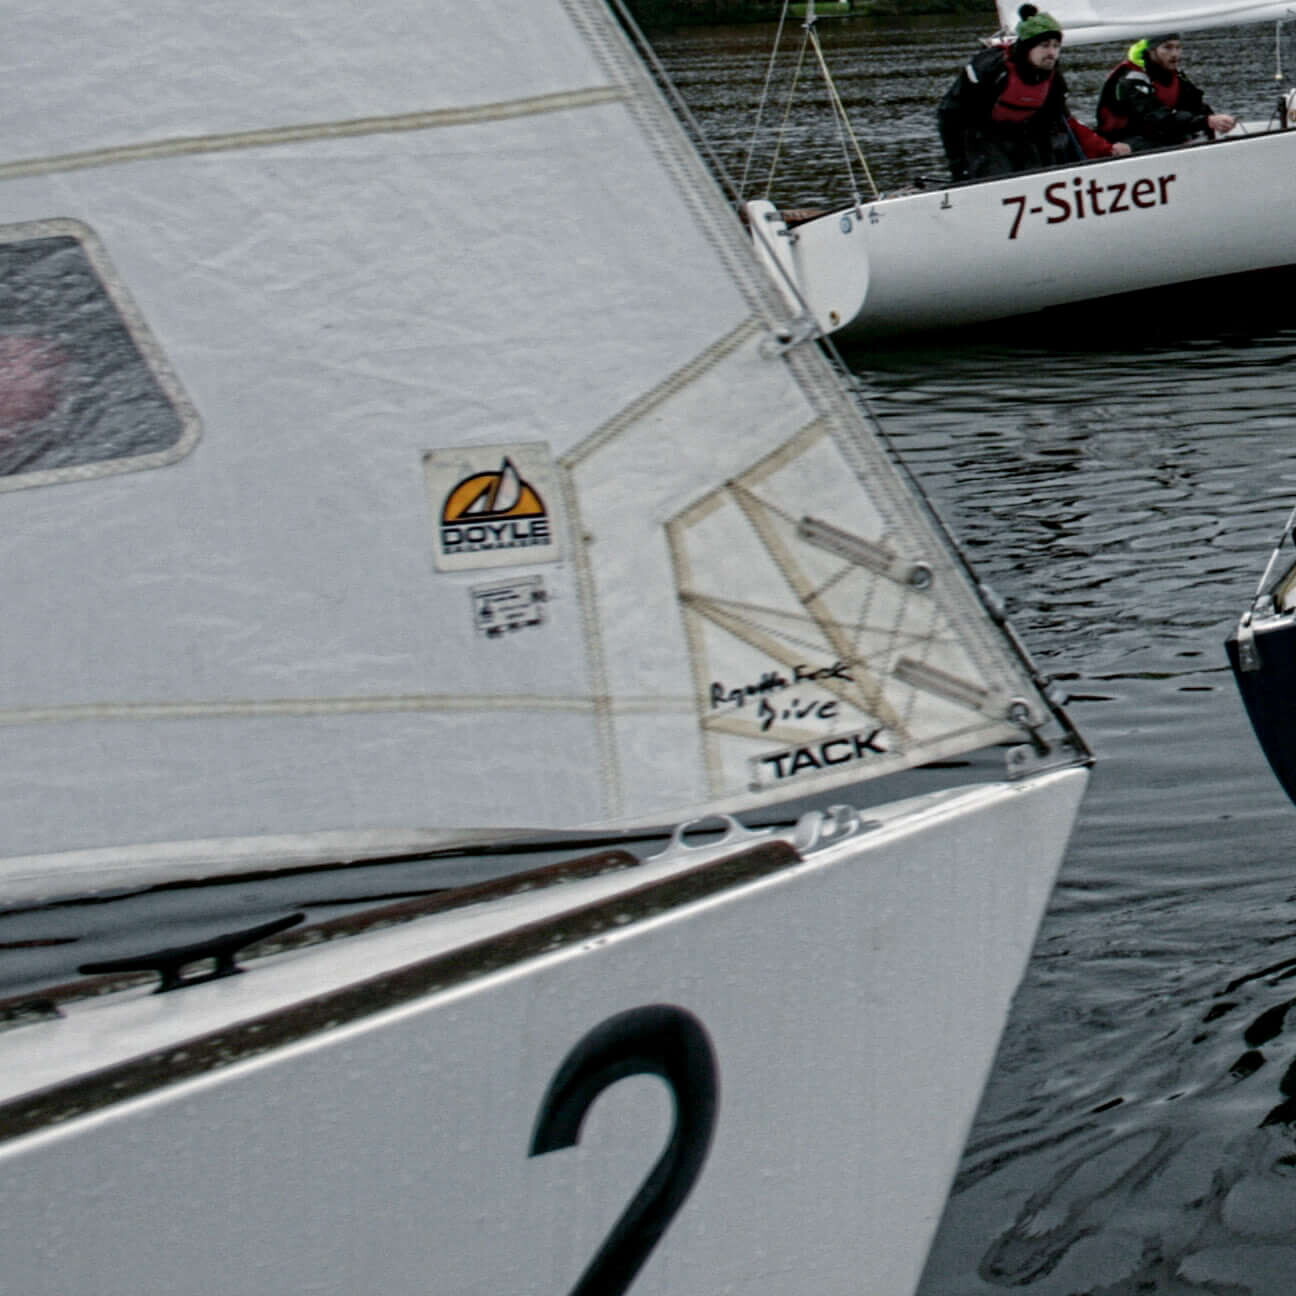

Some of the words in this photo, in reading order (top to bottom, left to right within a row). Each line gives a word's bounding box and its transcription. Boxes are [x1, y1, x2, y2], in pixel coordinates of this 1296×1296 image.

[1001, 173, 1178, 240] 7-Sitzer
[442, 519, 552, 546] DOYLE
[761, 727, 889, 780] TACK
